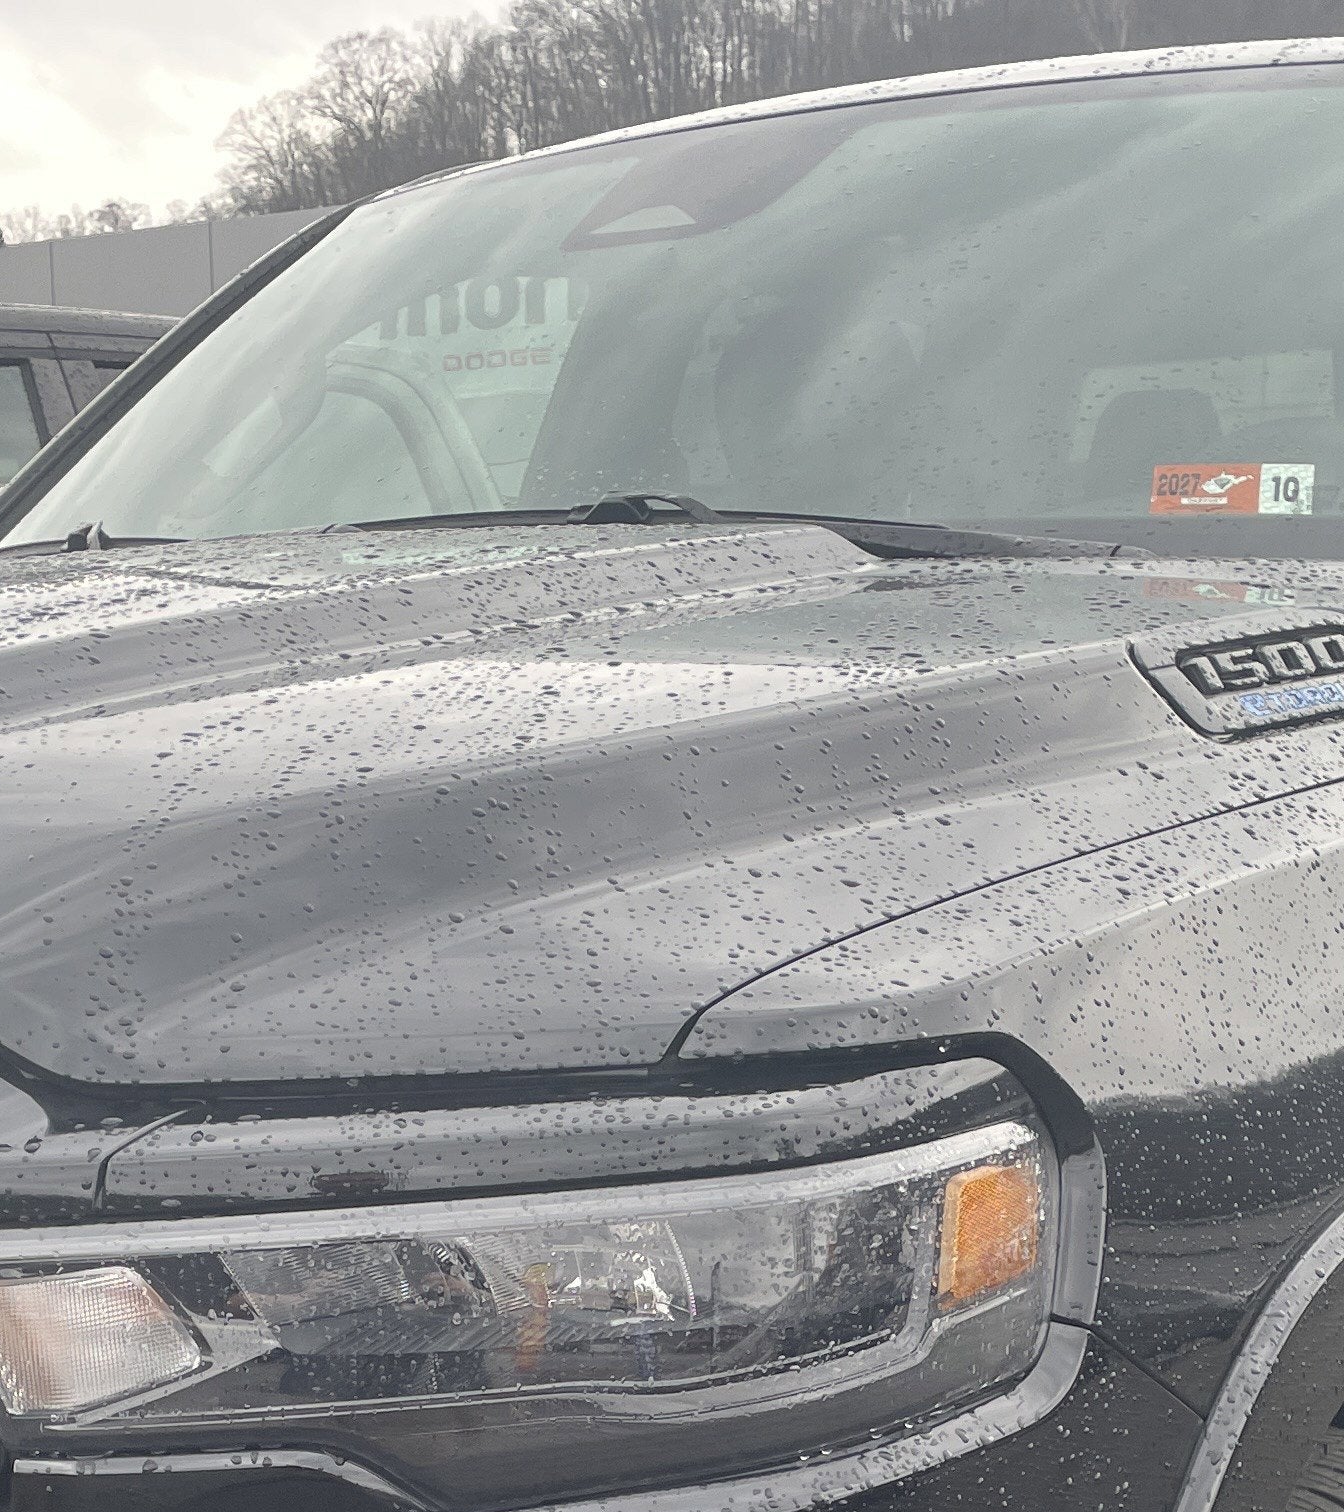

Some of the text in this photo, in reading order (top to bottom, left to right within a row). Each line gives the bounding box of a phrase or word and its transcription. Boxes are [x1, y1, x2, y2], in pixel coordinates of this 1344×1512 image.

[442, 347, 553, 372] DODGE
[1156, 473, 1201, 496] 2027
[1271, 475, 1300, 502] 10
